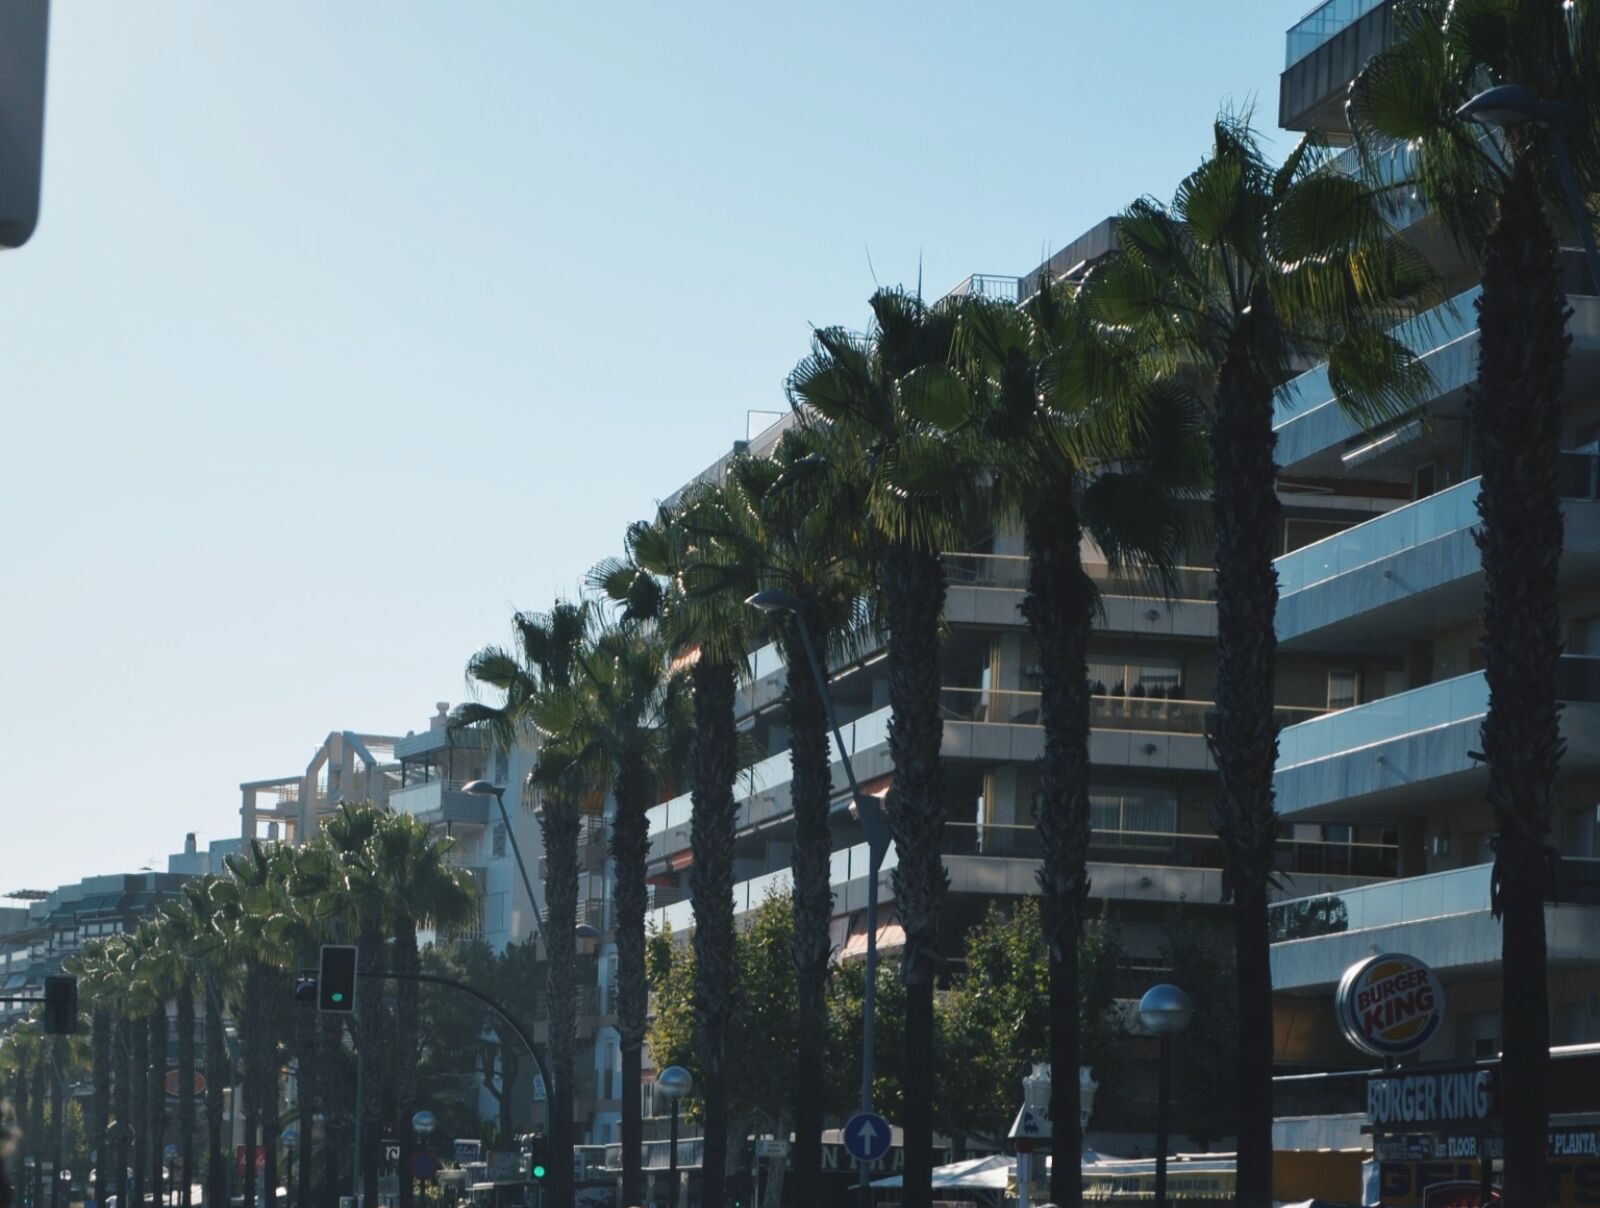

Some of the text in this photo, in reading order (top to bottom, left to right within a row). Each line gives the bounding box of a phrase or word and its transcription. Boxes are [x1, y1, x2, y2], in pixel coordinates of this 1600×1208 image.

[1357, 969, 1429, 1011] BURGER
[1364, 986, 1435, 1038] KING
[1368, 1070, 1490, 1123] BURGER KING
[1448, 1136, 1476, 1157] FLOOR
